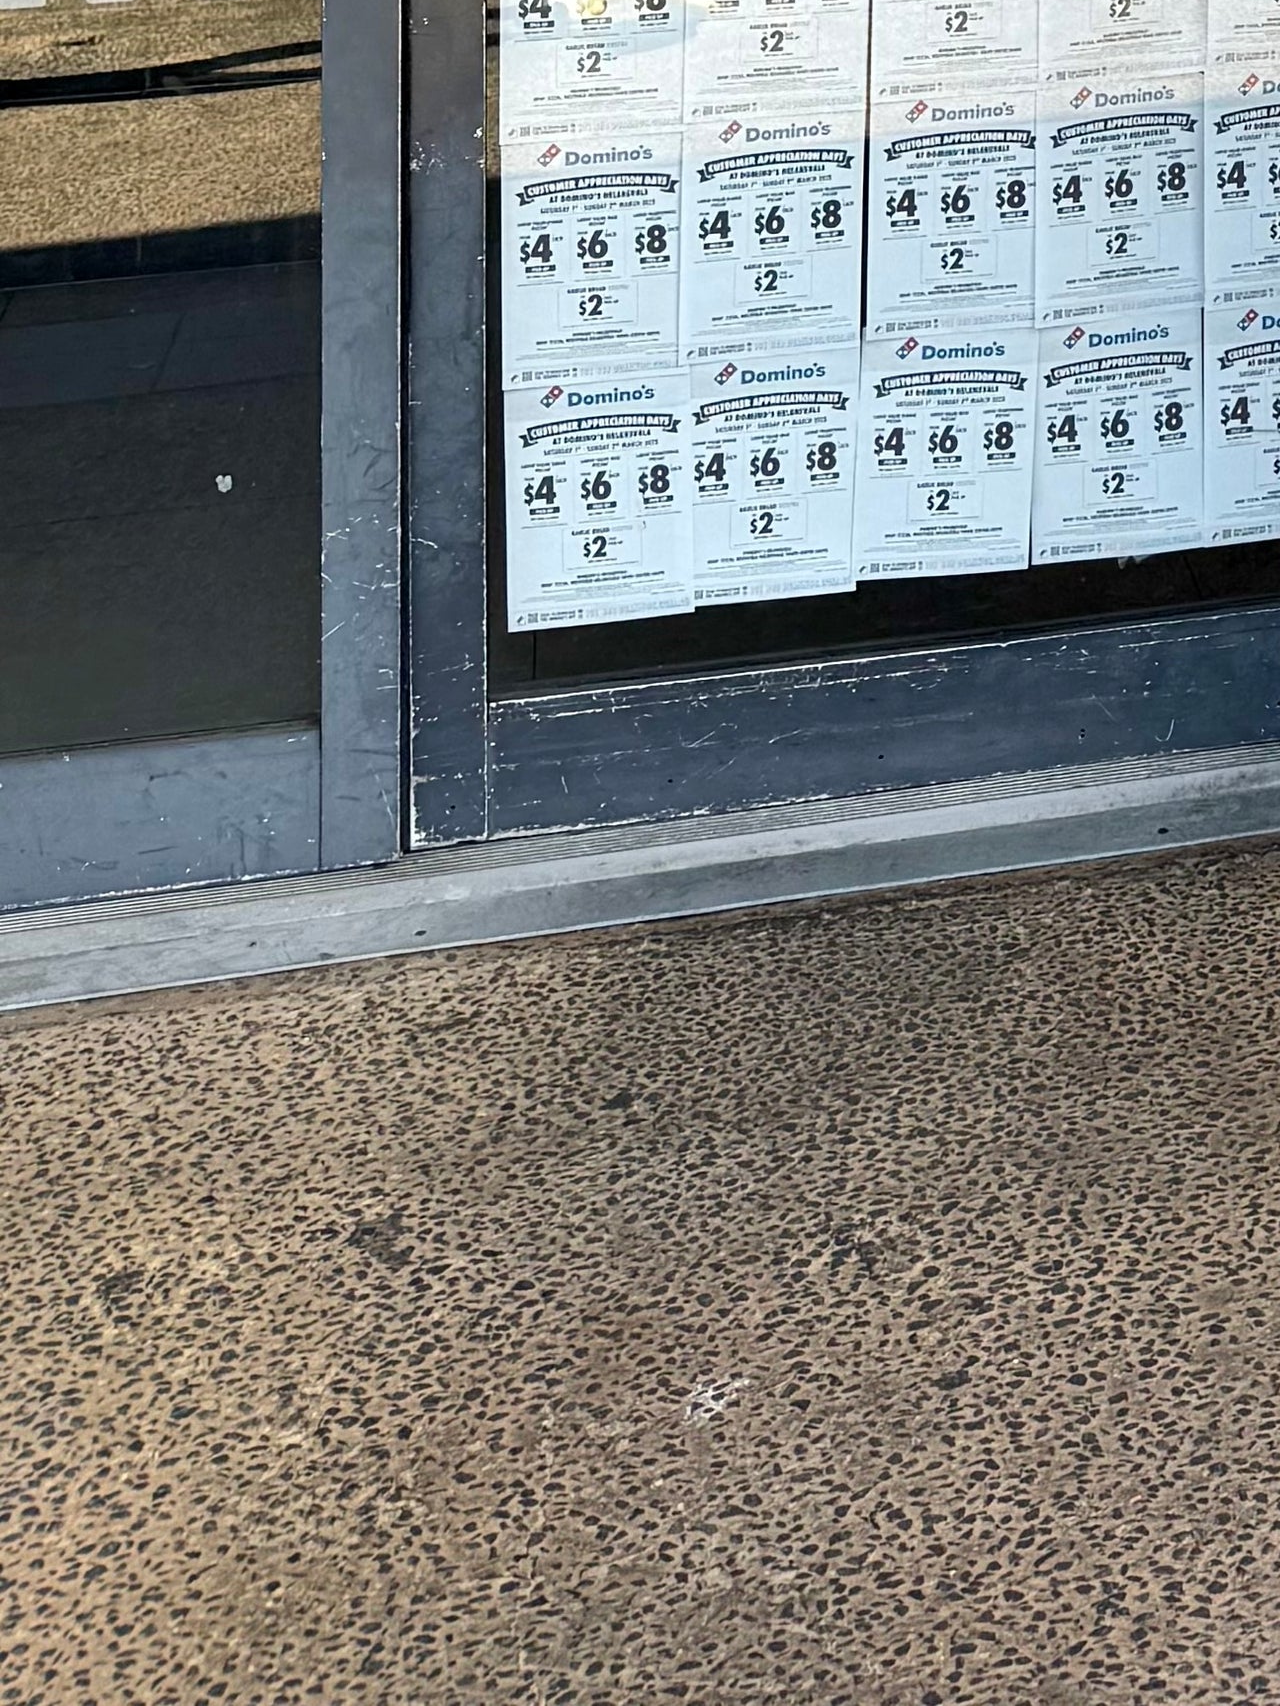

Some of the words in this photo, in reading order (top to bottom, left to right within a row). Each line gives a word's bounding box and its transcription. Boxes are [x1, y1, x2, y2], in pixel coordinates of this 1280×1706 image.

[745, 120, 832, 143] Domino's
[698, 209, 731, 242] $4
[754, 205, 785, 235] $6
[810, 199, 842, 230] $8
[568, 385, 655, 407] Domino's
[1220, 396, 1251, 426] $4
[523, 475, 557, 506] $4
[580, 470, 613, 501] $6
[638, 464, 670, 495] $8
